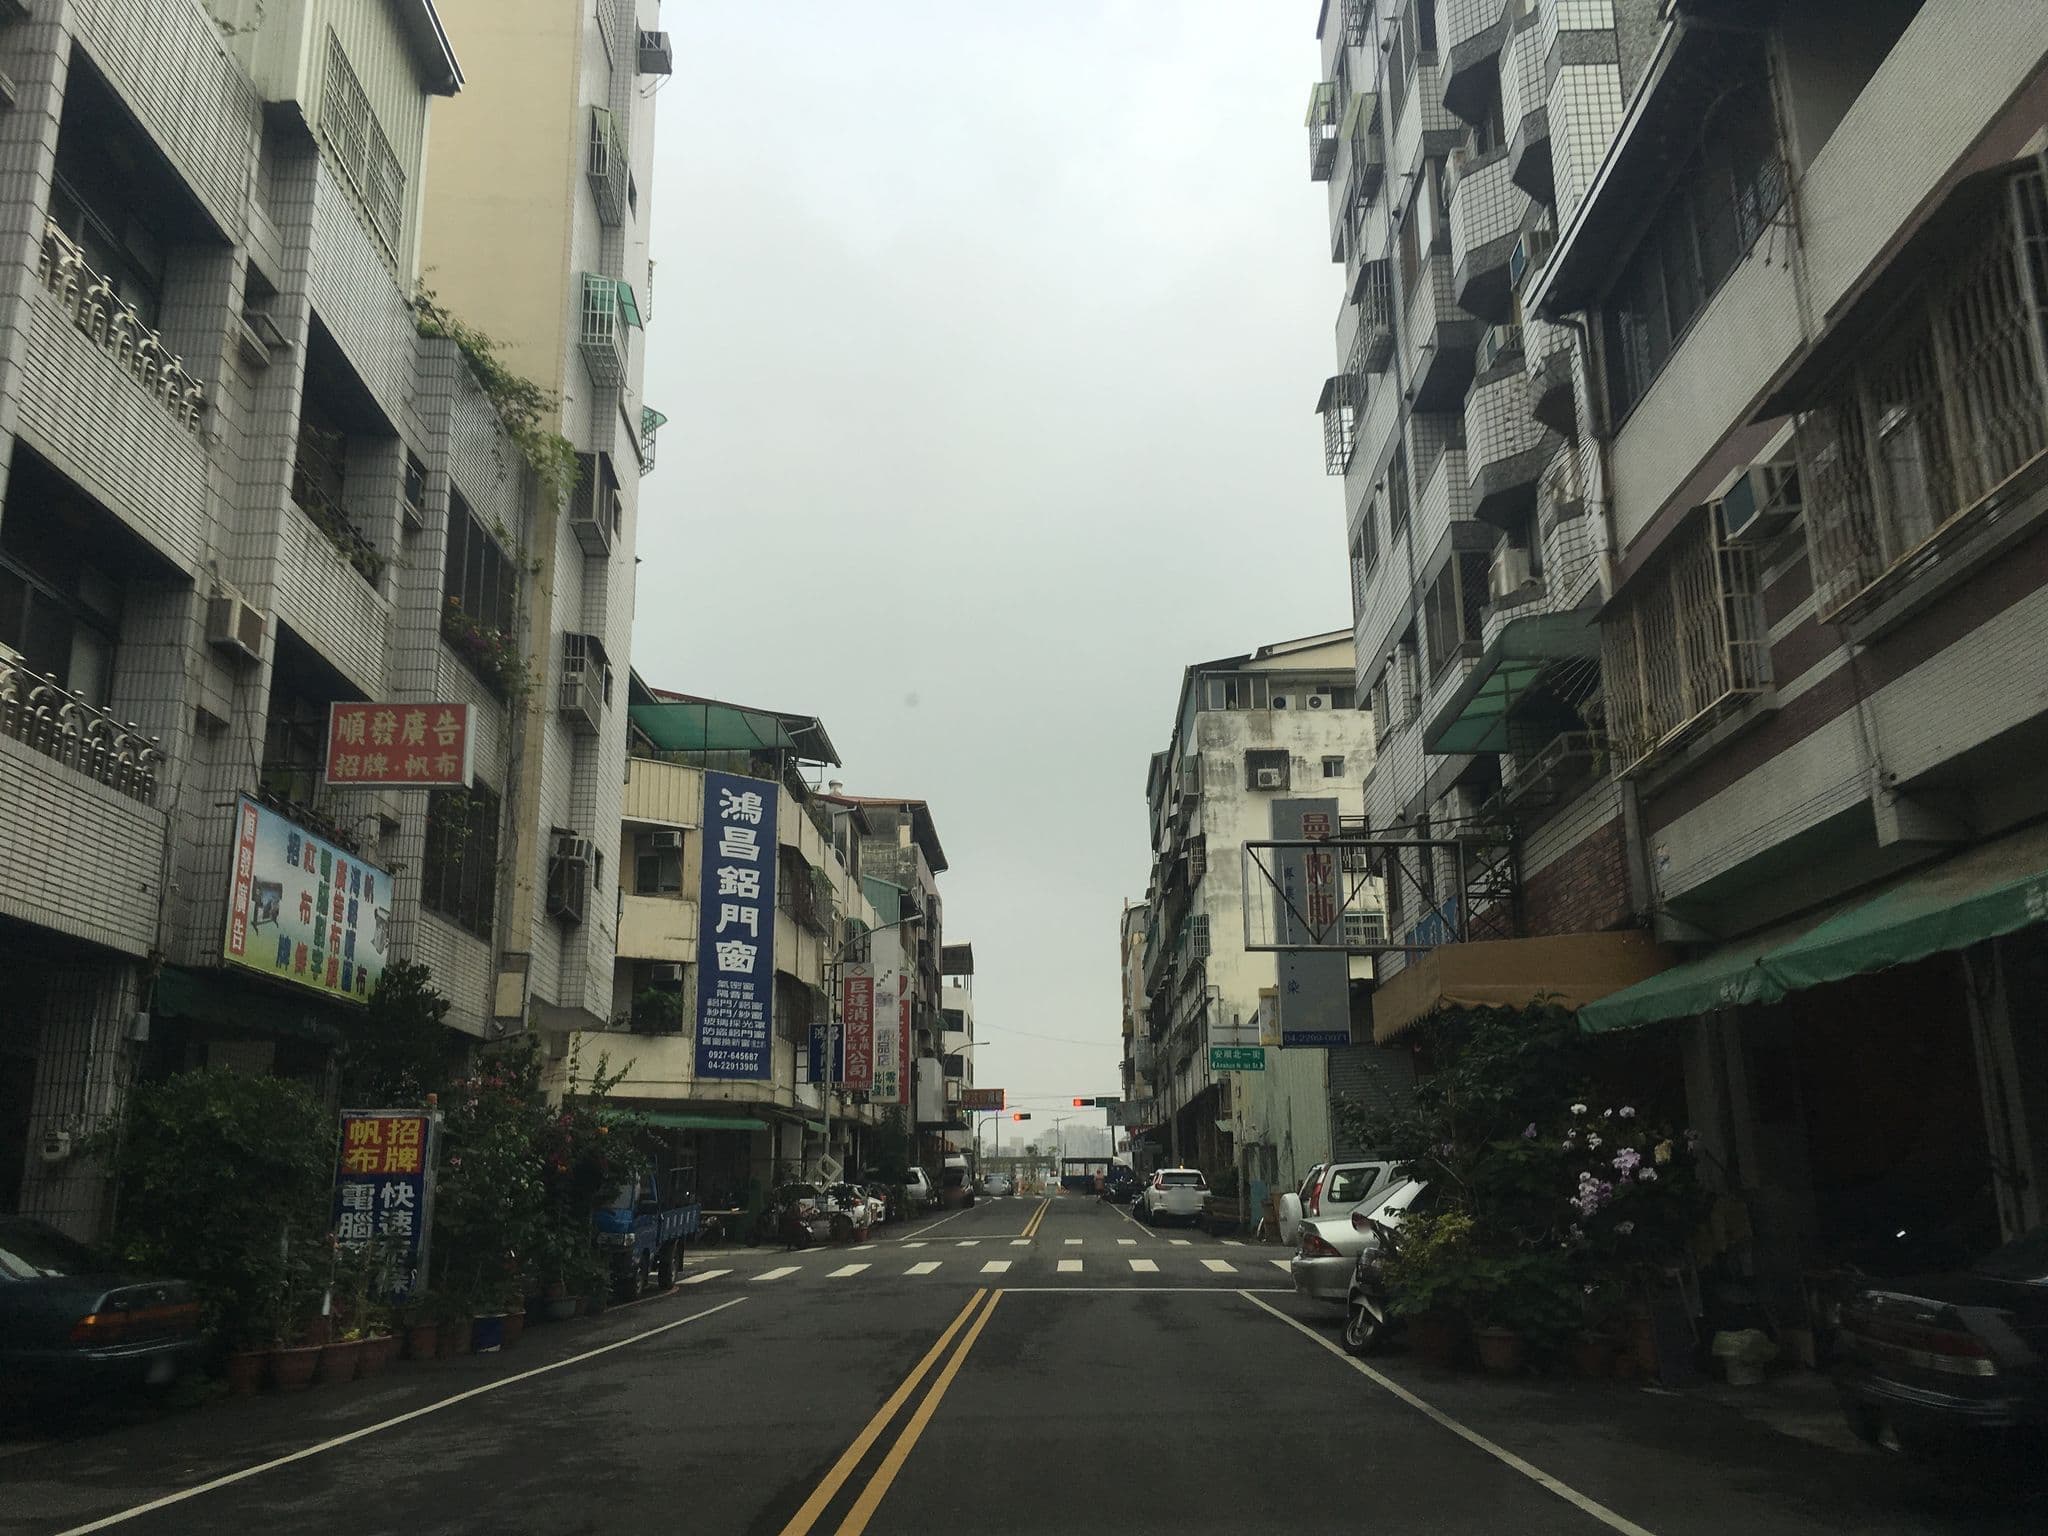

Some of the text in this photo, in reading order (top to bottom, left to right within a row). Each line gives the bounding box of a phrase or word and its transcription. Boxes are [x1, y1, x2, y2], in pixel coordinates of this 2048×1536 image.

[337, 708, 461, 746] 順發廣告
[715, 787, 763, 975] 鴻昌鋁門窗
[349, 1118, 382, 1173] 帆布
[384, 1118, 420, 1173] 招牌
